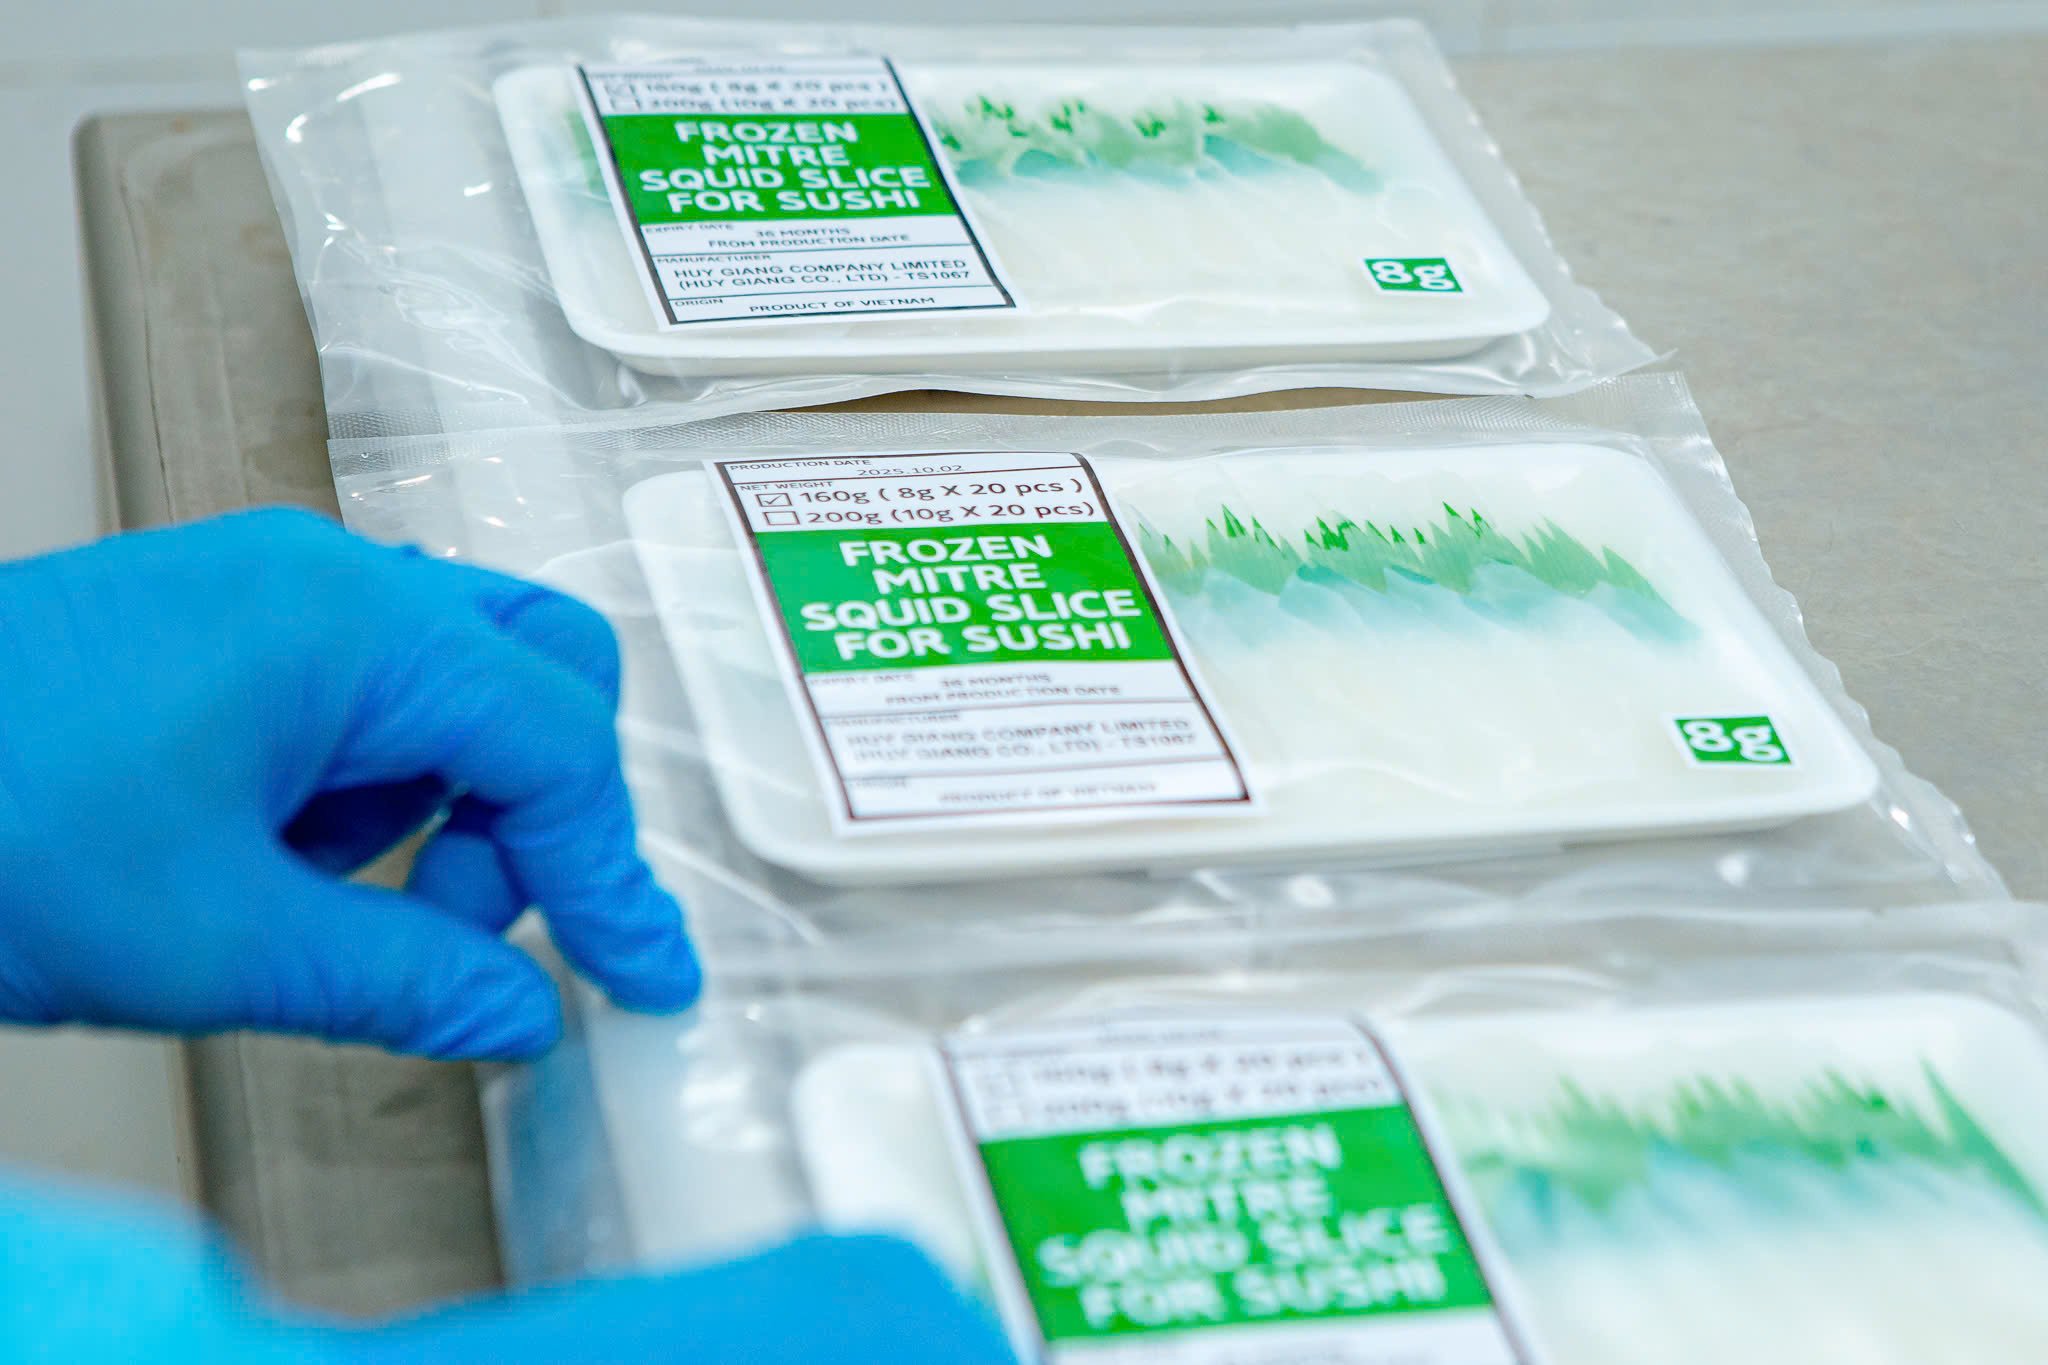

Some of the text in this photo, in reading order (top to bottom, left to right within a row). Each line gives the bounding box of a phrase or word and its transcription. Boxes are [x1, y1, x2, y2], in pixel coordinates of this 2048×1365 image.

[674, 121, 859, 143] FROZEN
[702, 144, 851, 167] MITRE
[639, 166, 931, 192] SQUID SLICE
[667, 189, 921, 213] FOR SUSHI
[645, 223, 736, 233] EXPIRY DATE
[756, 227, 851, 238] 36 MONTHS
[708, 234, 911, 249] FROM PRODUCTION DATE
[656, 254, 772, 264] MANUFACTURER
[673, 259, 967, 279] HUY GIANG COMPANY LIMITED
[679, 278, 726, 291] (HUY
[732, 275, 795, 287] GIANG
[801, 273, 841, 284] CO.,
[847, 272, 889, 283] LTD)
[907, 270, 971, 281] TS1067
[1371, 260, 1456, 291] 8g
[674, 298, 724, 307] ORIGIN
[749, 297, 936, 313] PRODUCT OF VIETNAM
[730, 459, 872, 471] PRODUCTION DATE
[857, 463, 965, 477] 2025.10.02
[739, 481, 835, 492] NET WEIGHT
[800, 490, 871, 505] 160g
[898, 486, 936, 502] 8g
[940, 484, 963, 497] X
[969, 482, 1007, 495] 20
[1014, 481, 1065, 497] pcs
[806, 501, 1095, 526] 200g (10g X 20 pcs)
[839, 534, 1054, 567] FROZEN
[871, 563, 1048, 595] MITRE
[799, 590, 1143, 633] SQUID SLICE
[834, 622, 1132, 661] FOR SUSHI
[981, 721, 1094, 741] COMPANY
[1100, 719, 1190, 736] LIMITED
[1682, 719, 1784, 763] 8g
[1077, 1124, 1343, 1190] FROZEN
[1120, 1176, 1334, 1230] MITRE
[1035, 1203, 1451, 1288] SQUID SLICE
[1077, 1258, 1449, 1330] FOR SUSHI
